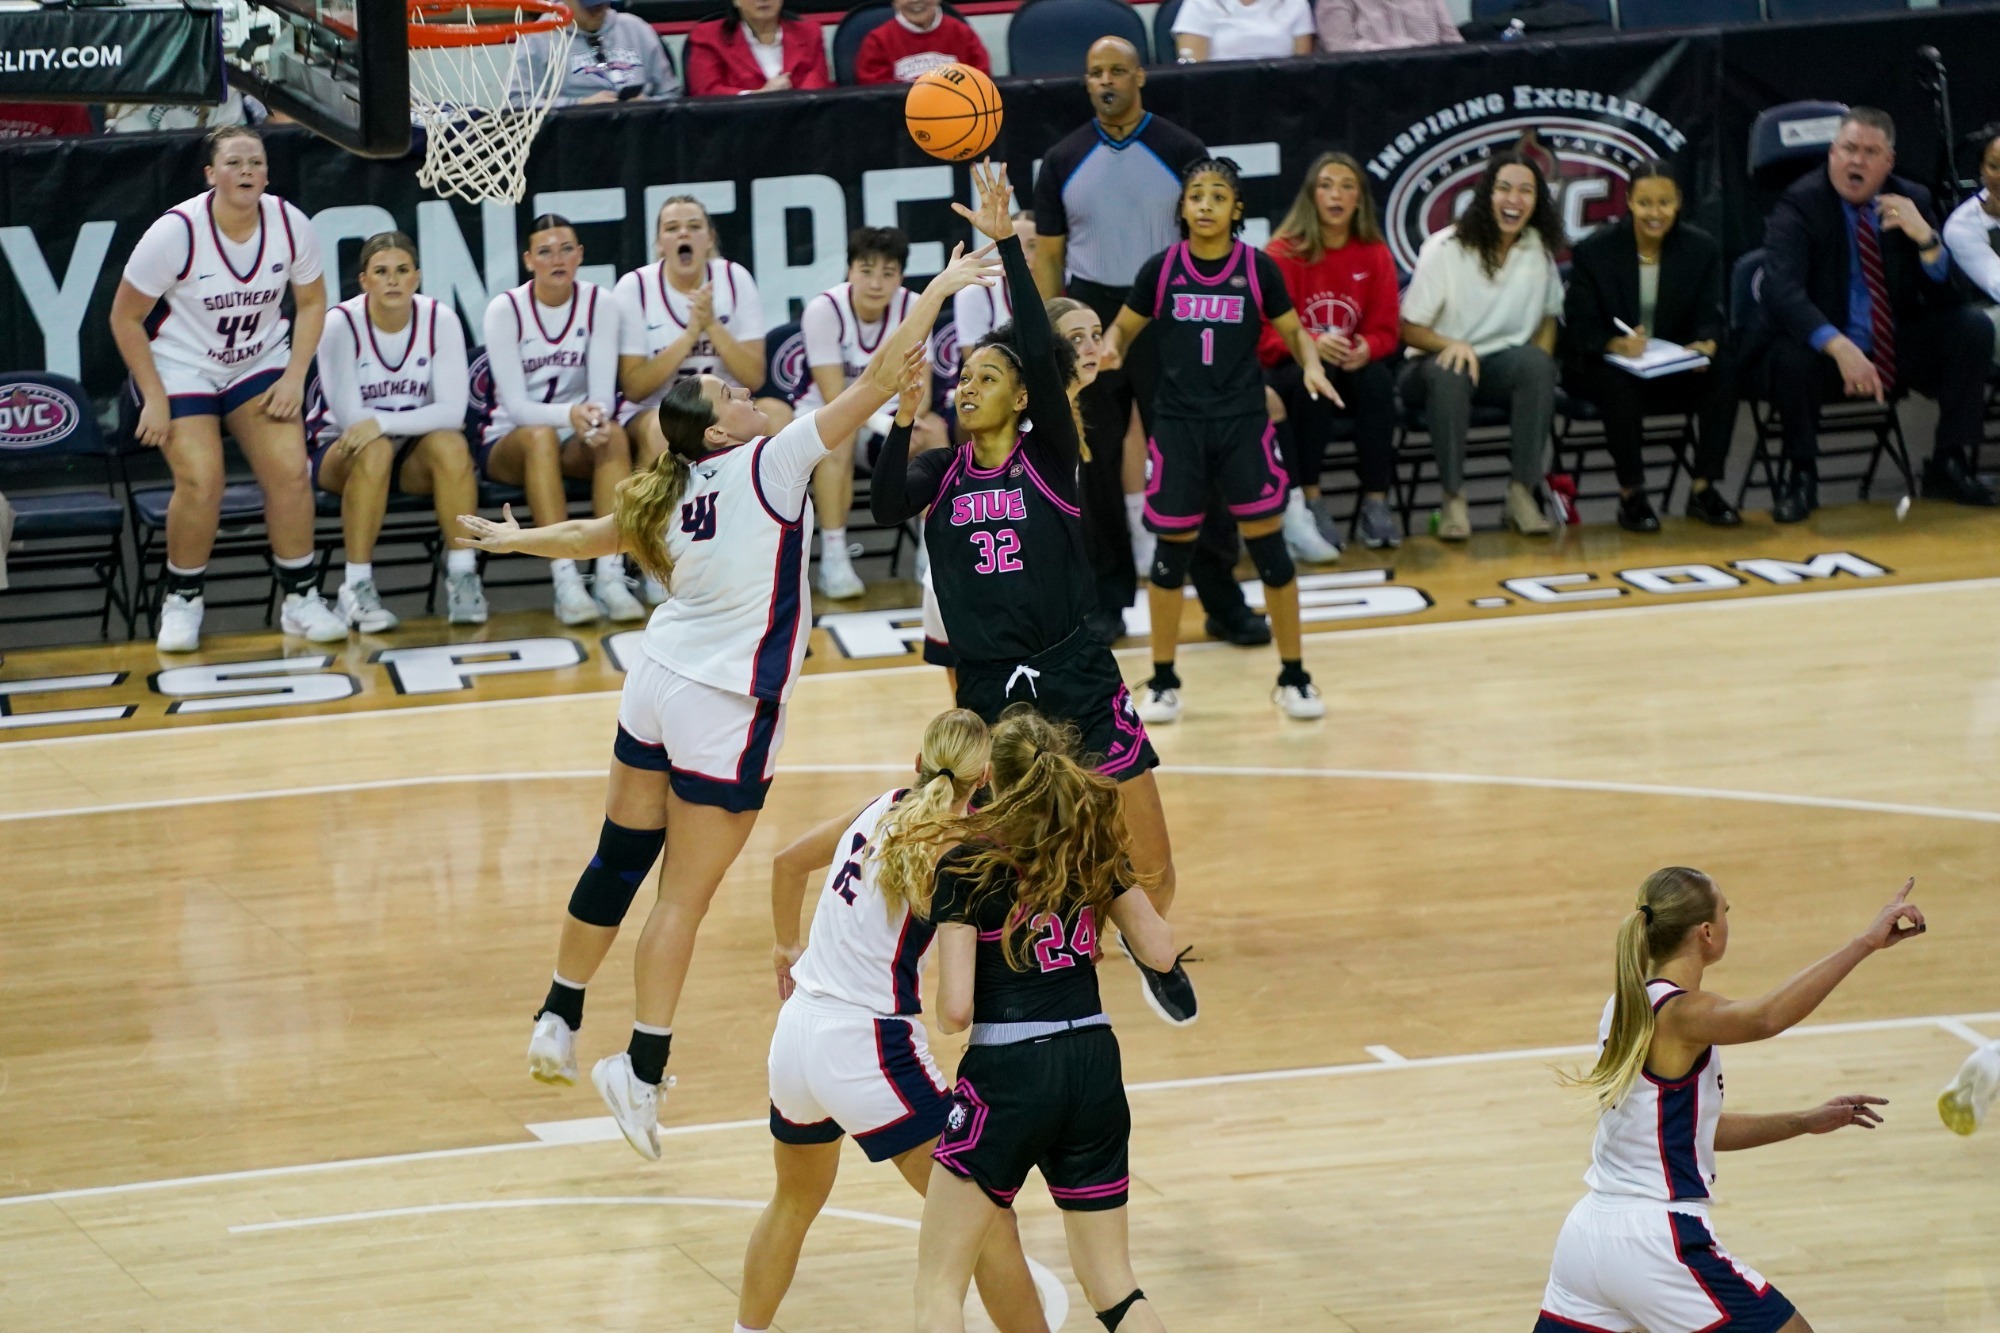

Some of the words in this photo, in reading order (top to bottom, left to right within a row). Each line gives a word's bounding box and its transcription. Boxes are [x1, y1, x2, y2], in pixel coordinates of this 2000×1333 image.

[1366, 93, 1504, 181] INSPIRING
[1513, 85, 1687, 152] EXCELLENCE
[203, 287, 281, 311] SOUTHERN
[1172, 293, 1245, 323] SIUE
[216, 311, 262, 348] 44
[1200, 327, 1214, 365] 1
[360, 378, 430, 400] SOUTHERN
[950, 487, 1027, 526] SIUE
[969, 528, 1024, 574] 32
[1030, 904, 1097, 973] 24
